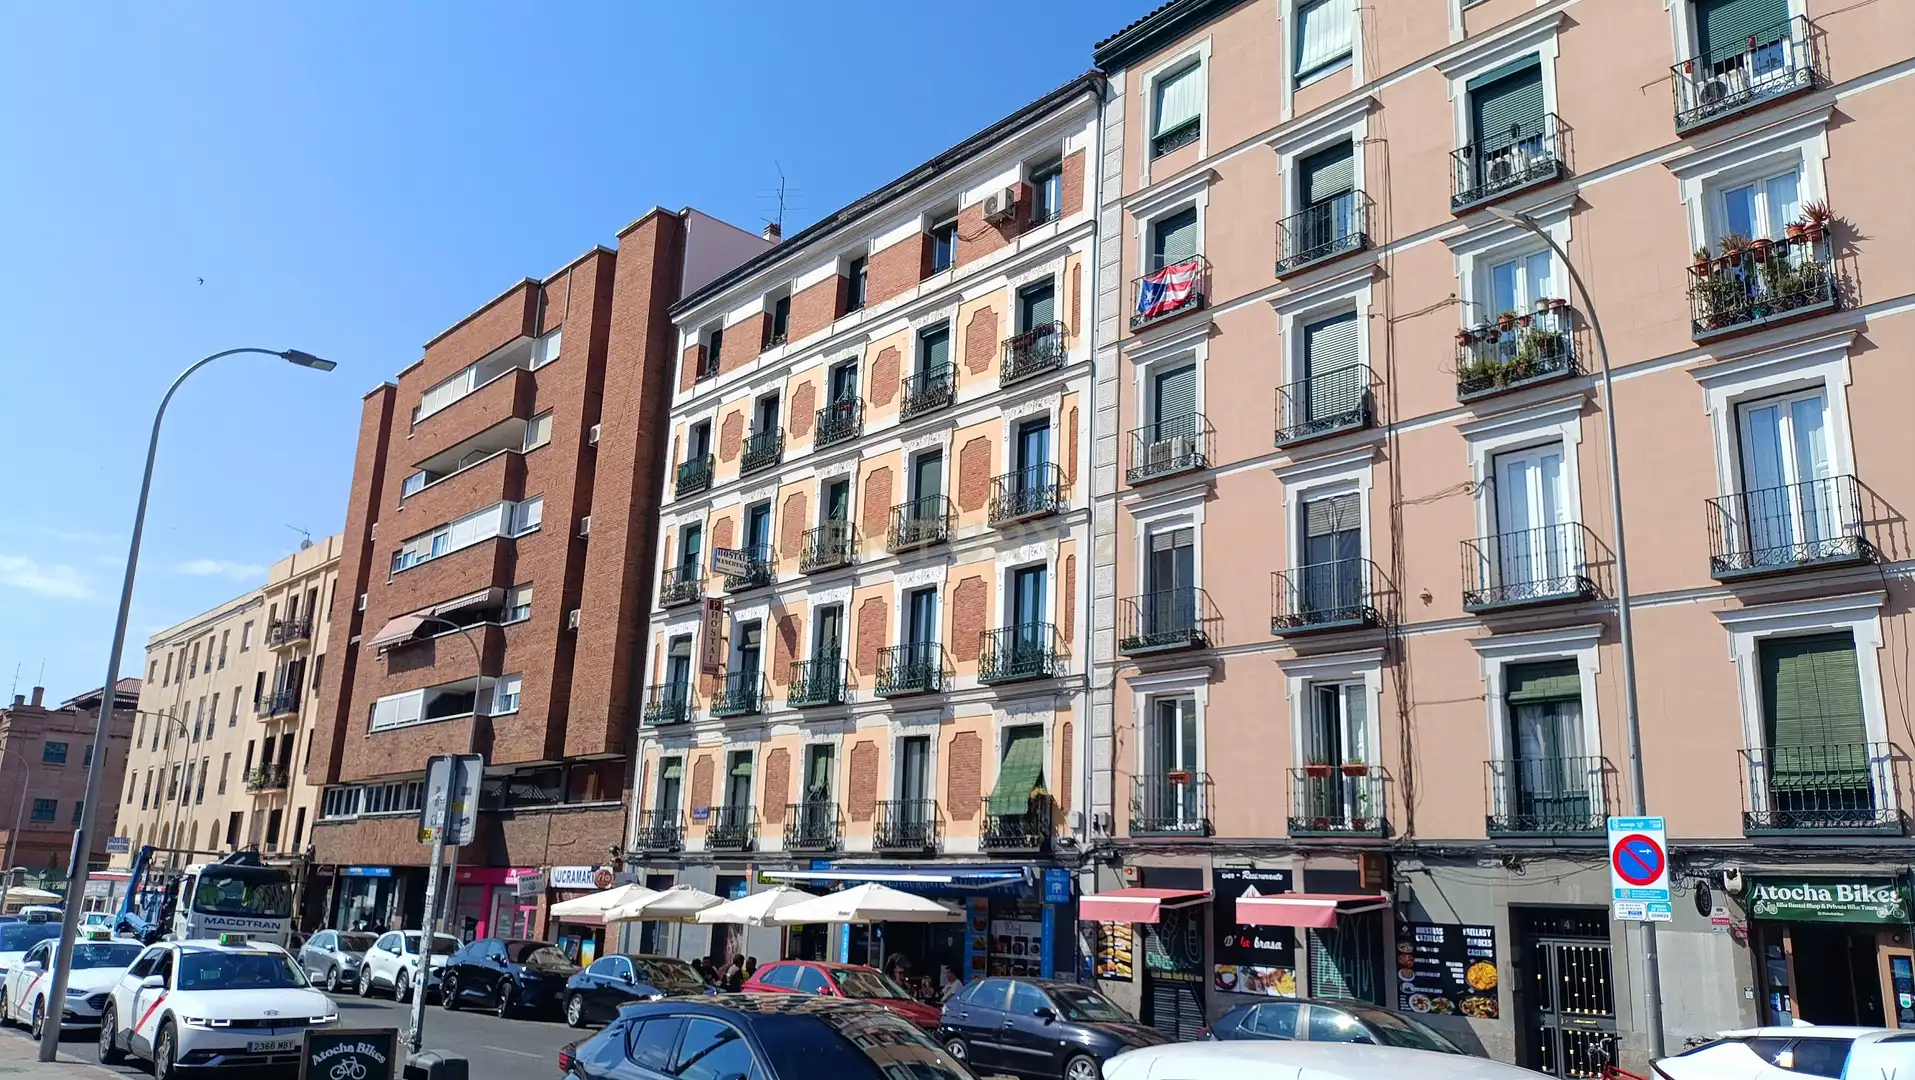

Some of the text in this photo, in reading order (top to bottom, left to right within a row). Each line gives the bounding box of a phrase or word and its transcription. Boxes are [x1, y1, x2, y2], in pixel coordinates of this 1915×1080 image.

[717, 549, 748, 563] HOSTAL
[708, 611, 719, 663] HOSTAL
[1752, 883, 1903, 903] Atocha Bikes
[204, 917, 281, 929] MACOTRAN
[1564, 920, 1570, 929] 4
[1240, 936, 1250, 948] la
[1254, 936, 1283, 950] brasa
[311, 1042, 387, 1066] Atocha Bikes
